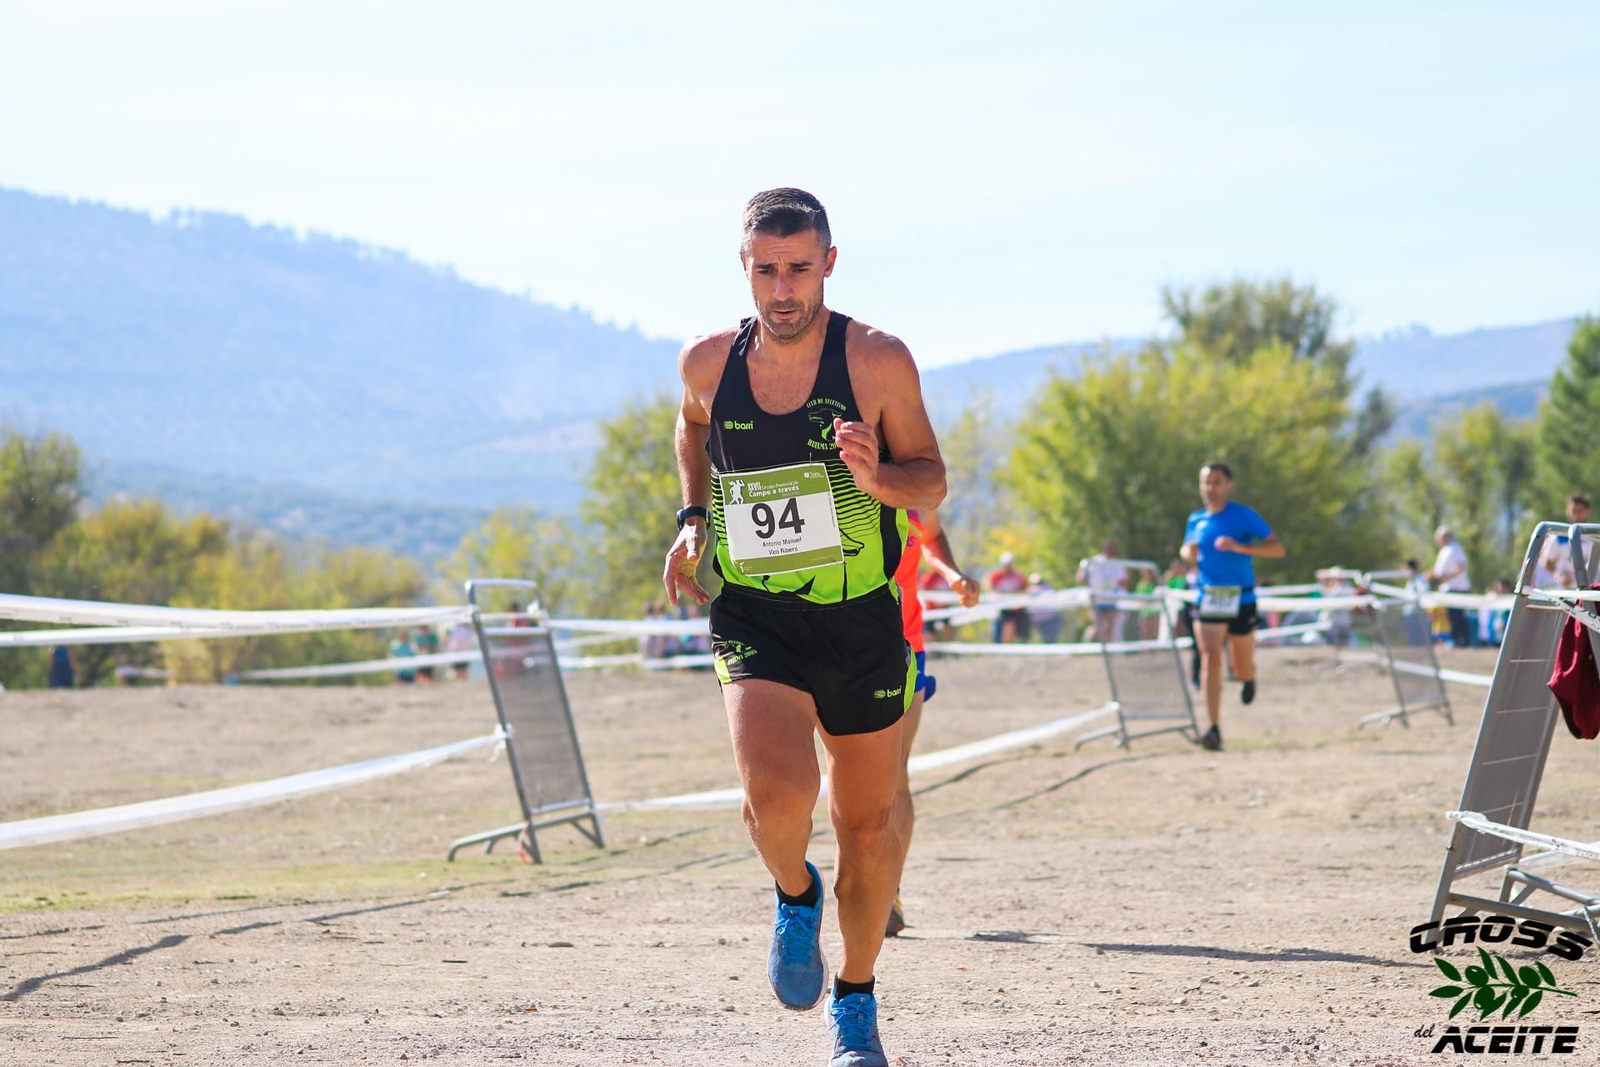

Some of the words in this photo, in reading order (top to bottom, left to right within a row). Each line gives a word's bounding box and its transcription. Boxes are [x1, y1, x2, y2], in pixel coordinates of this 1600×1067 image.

[734, 420, 754, 430] barri
[748, 490, 771, 498] Campo
[778, 485, 800, 494] través
[751, 497, 805, 539] 94
[782, 536, 802, 545] Manuel
